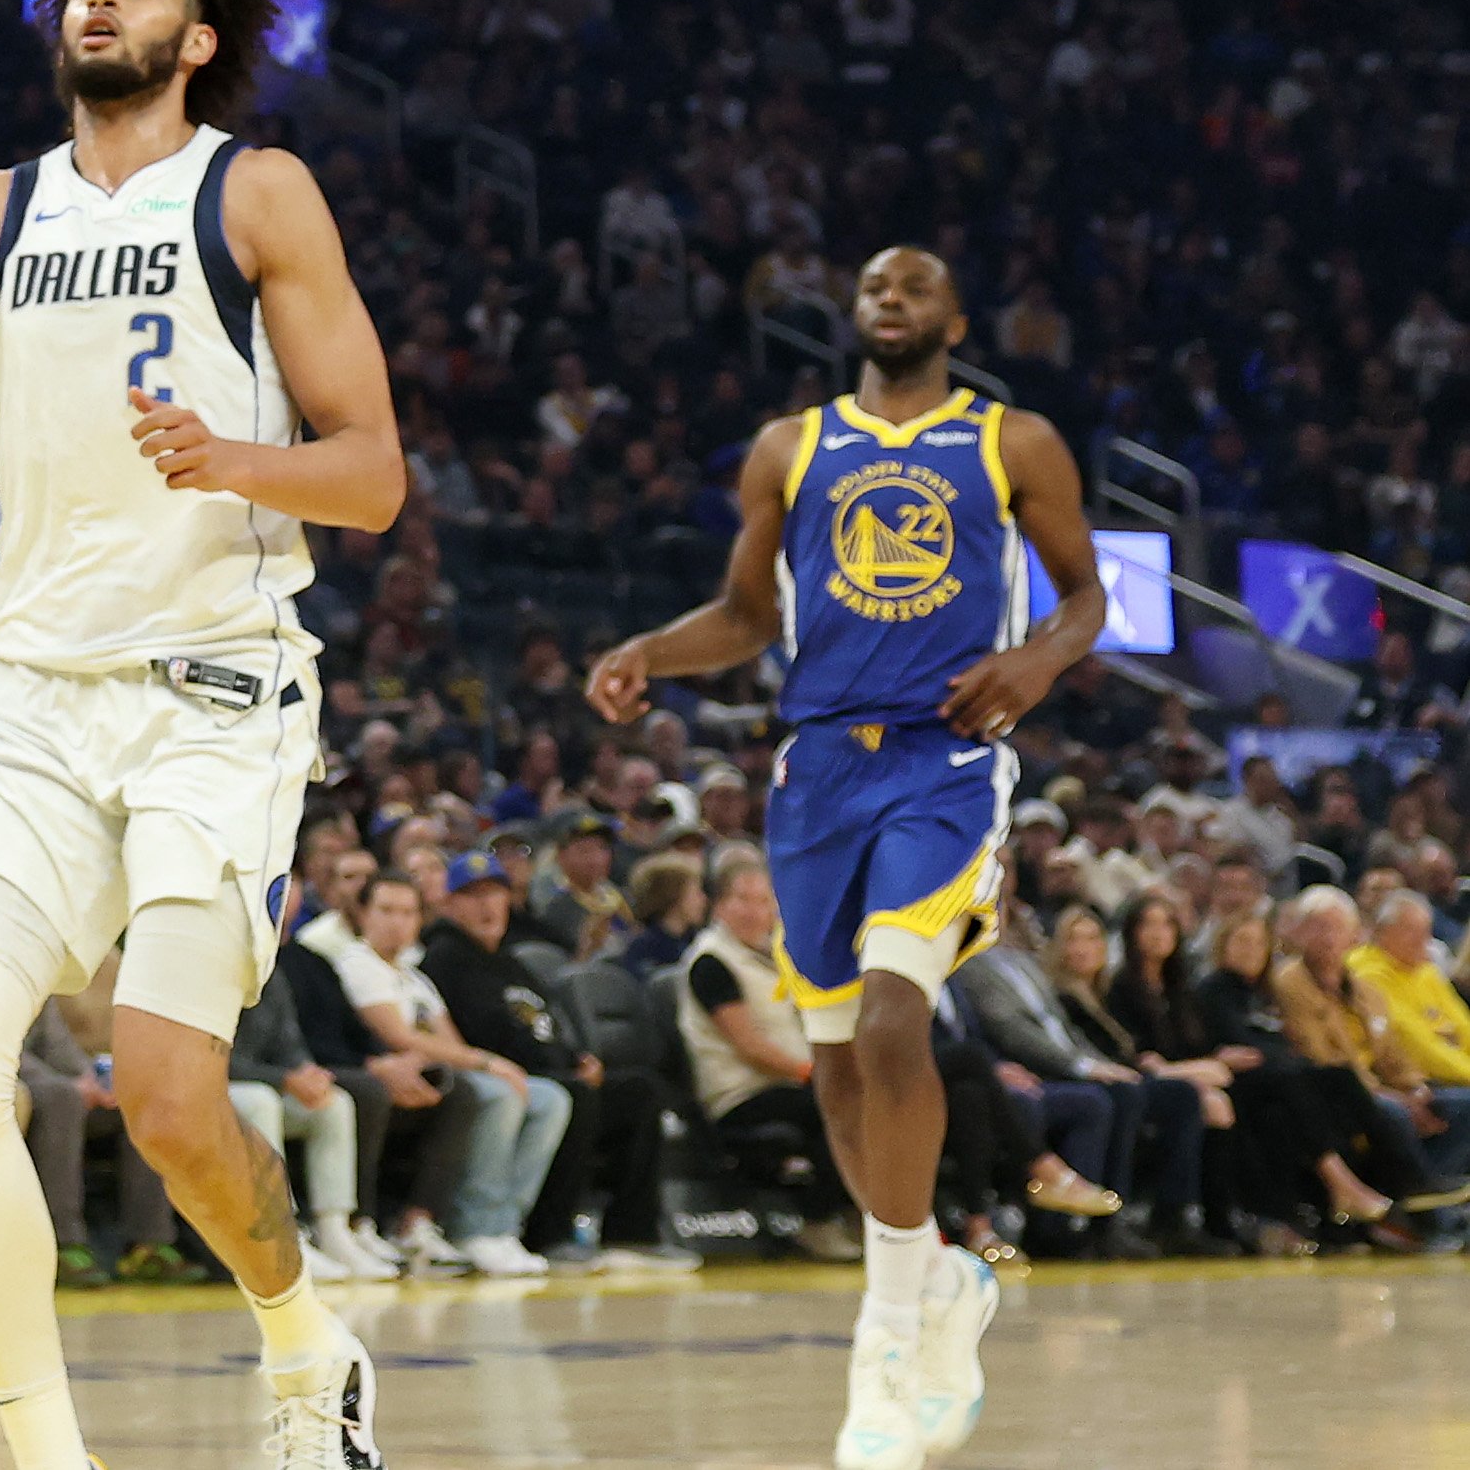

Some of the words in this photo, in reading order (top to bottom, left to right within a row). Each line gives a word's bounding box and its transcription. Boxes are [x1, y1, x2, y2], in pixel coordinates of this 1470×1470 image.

[12, 242, 180, 312] DALLAS
[128, 312, 174, 407] 2
[827, 460, 903, 503] GOLDEN
[907, 465, 960, 503] STATE
[896, 504, 945, 543] 22
[825, 571, 963, 622] WARRIORS
